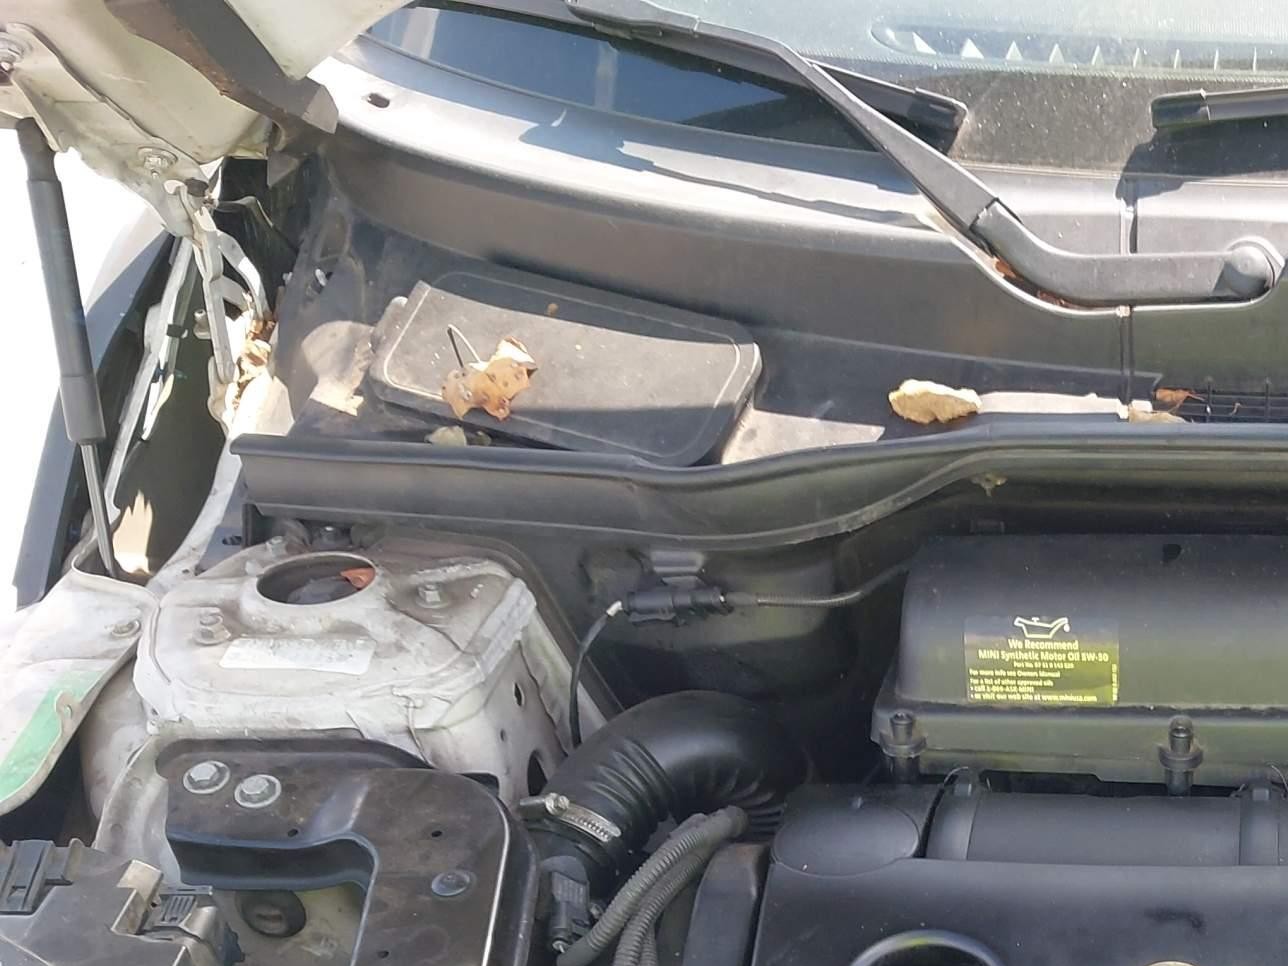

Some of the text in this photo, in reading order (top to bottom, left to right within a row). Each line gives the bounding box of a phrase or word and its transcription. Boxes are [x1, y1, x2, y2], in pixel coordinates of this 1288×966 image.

[1008, 639, 1079, 650] We Recommend
[979, 650, 1000, 659] MINI
[1001, 650, 1039, 662] Synthetic
[1041, 651, 1066, 661] Motor
[1067, 652, 1080, 661] Oil
